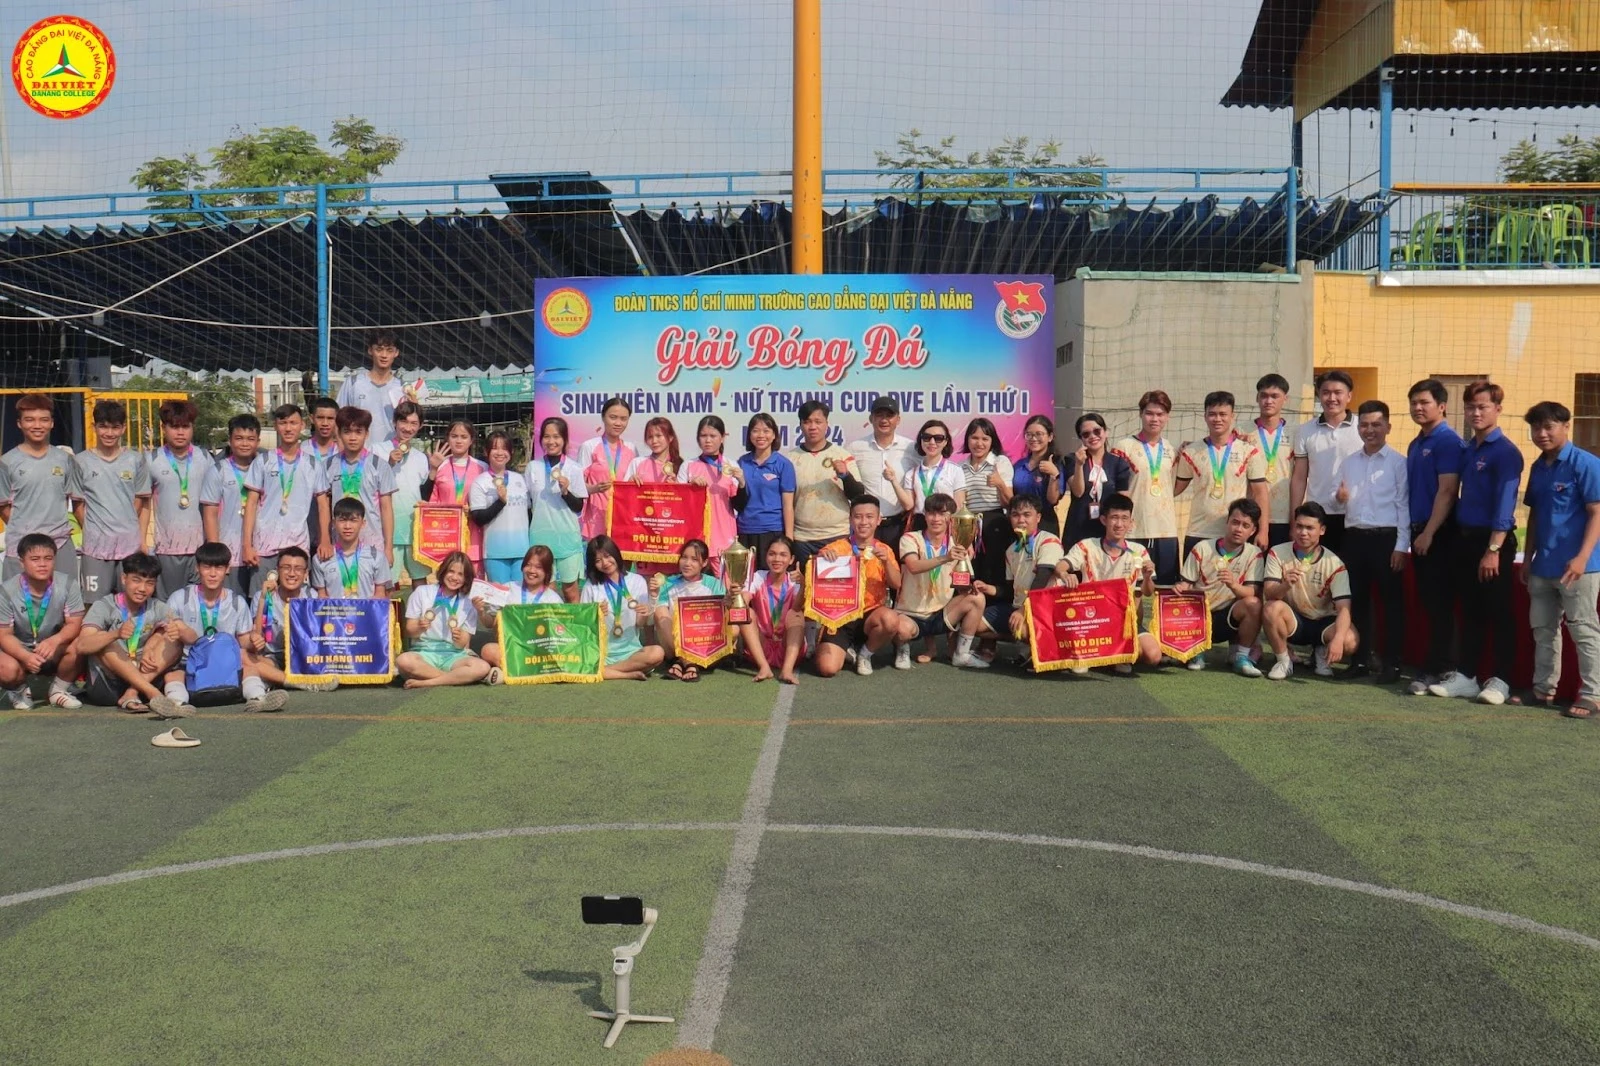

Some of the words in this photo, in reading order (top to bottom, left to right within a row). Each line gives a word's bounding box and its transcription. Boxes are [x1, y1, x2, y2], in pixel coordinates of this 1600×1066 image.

[614, 292, 646, 312] ĐOÀN
[650, 294, 680, 312] TNCS
[682, 289, 698, 311] HỒ
[702, 291, 722, 311] CHÍ
[725, 294, 756, 310] MINH
[758, 290, 805, 310] TRƯỜNG
[808, 293, 831, 310] CAO
[834, 286, 866, 310] ĐẲNG
[870, 293, 889, 313] ĐẠI
[893, 290, 918, 313] VIỆT
[920, 290, 936, 310] ĐÀ
[940, 288, 973, 310] NẴNG
[656, 324, 739, 385] Giải
[746, 323, 855, 385] Bóng
[862, 323, 927, 369] Đá
[522, 378, 532, 392] 3
[562, 392, 608, 414] SINH
[666, 392, 713, 413] NAM
[734, 388, 764, 413] NỮ
[768, 391, 833, 413] TRANH
[931, 384, 970, 413] LẦN
[977, 387, 1017, 413] THỨ
[1021, 392, 1028, 413] I
[86, 576, 98, 592] 15
[1074, 638, 1086, 648] VÔ
